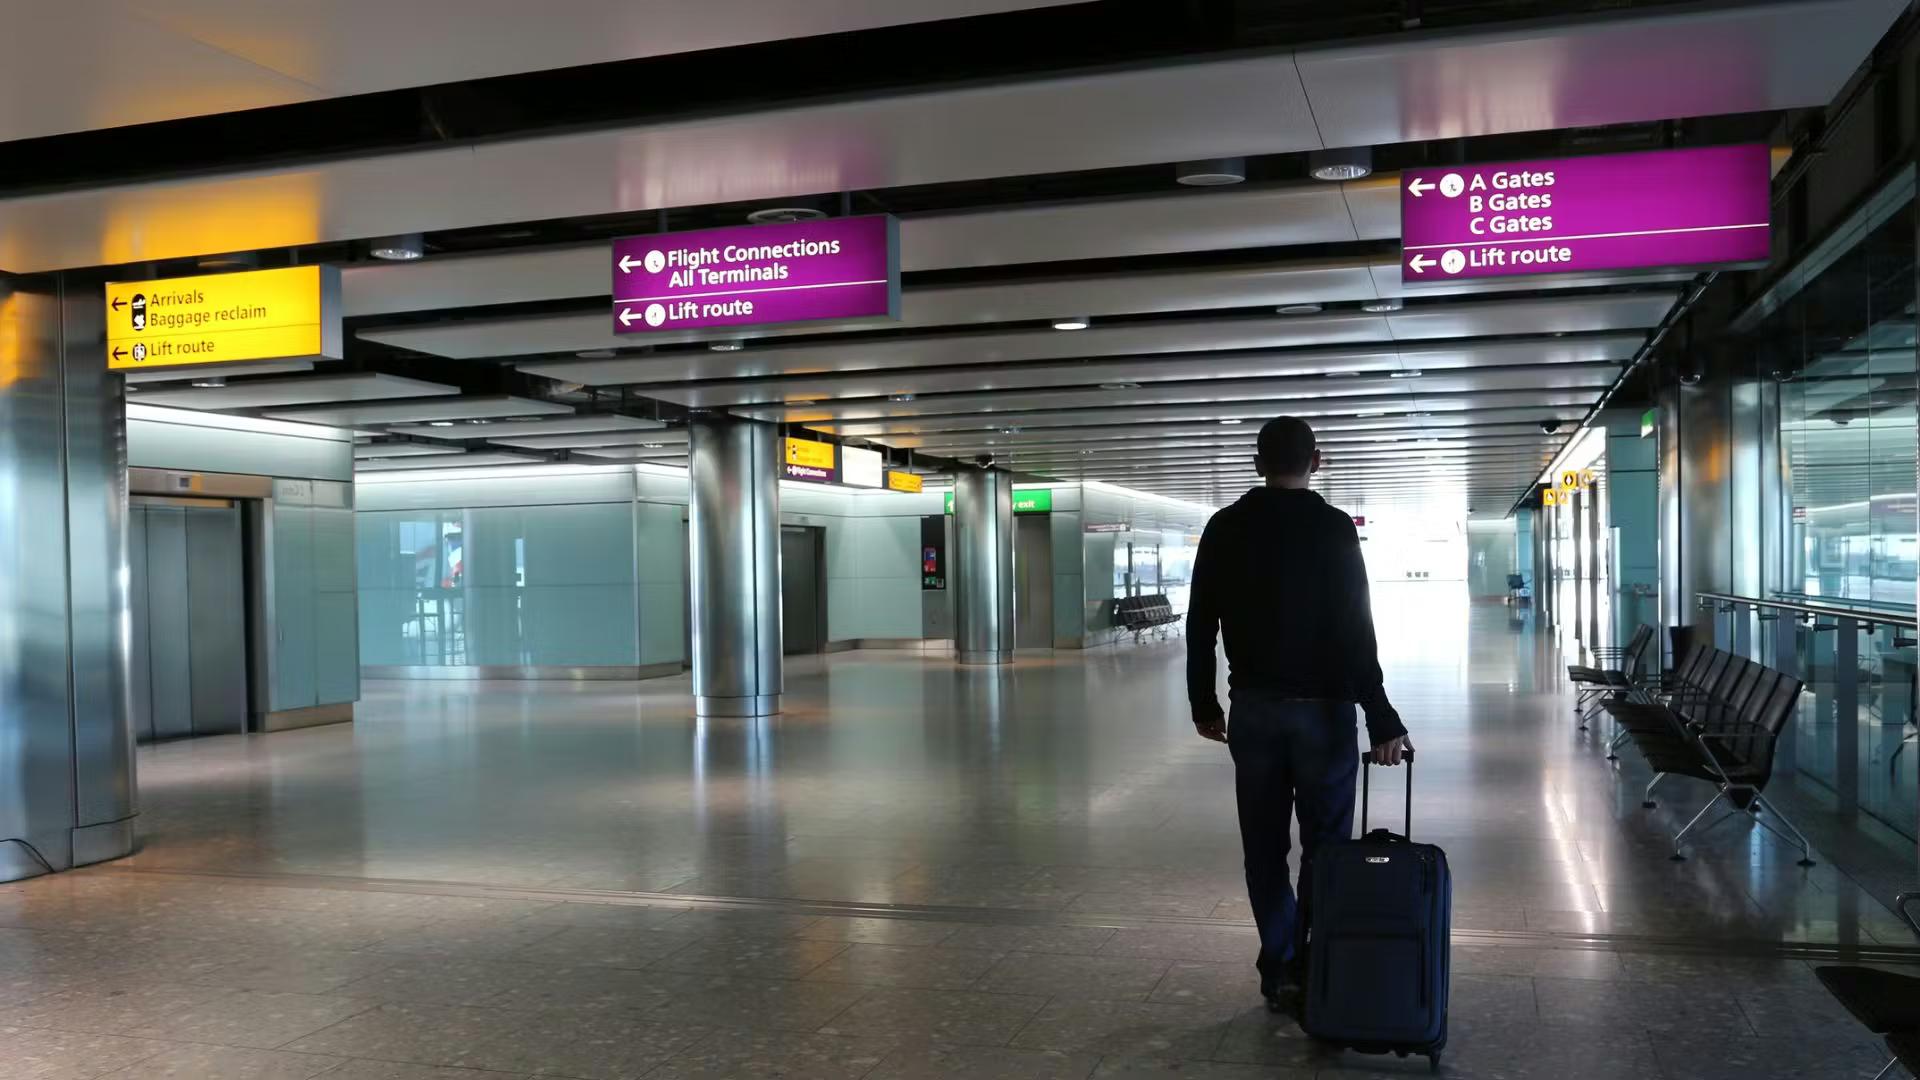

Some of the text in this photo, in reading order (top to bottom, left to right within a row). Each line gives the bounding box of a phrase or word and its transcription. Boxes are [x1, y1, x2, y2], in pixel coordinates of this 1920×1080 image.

[1469, 170, 1555, 191] A Gates
[1469, 192, 1552, 213] B Gates
[1469, 215, 1553, 235] C Gates
[668, 239, 841, 268] Flight Connections
[1469, 245, 1572, 267] Lift route
[668, 262, 789, 289] All Terminals
[150, 289, 204, 307] Arrivals
[150, 304, 267, 329] Baggage reclaim
[668, 299, 754, 321] Lift route
[150, 339, 215, 357] Lift route
